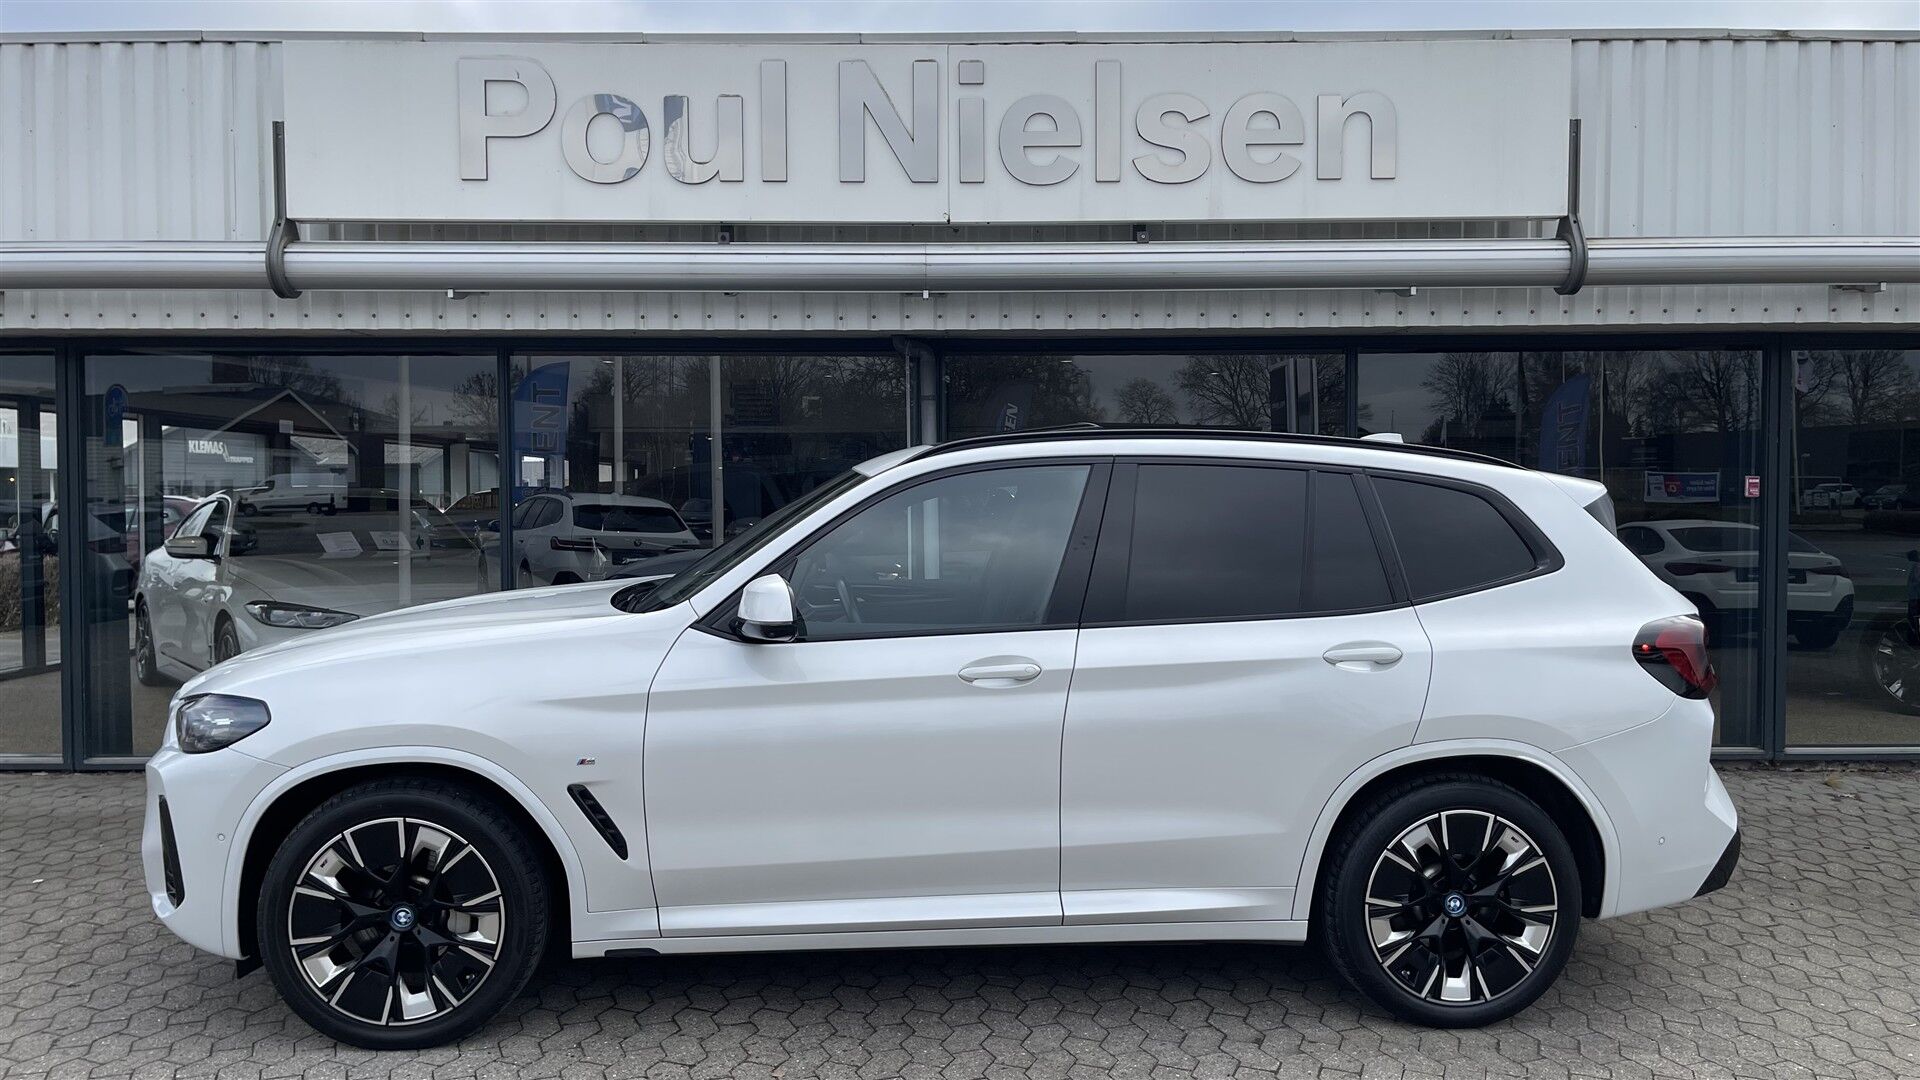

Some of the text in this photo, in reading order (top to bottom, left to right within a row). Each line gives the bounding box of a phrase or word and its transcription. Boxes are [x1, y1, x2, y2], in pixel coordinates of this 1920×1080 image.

[457, 55, 1398, 186] Poul Nielsen
[188, 440, 224, 455] KLEMAS
